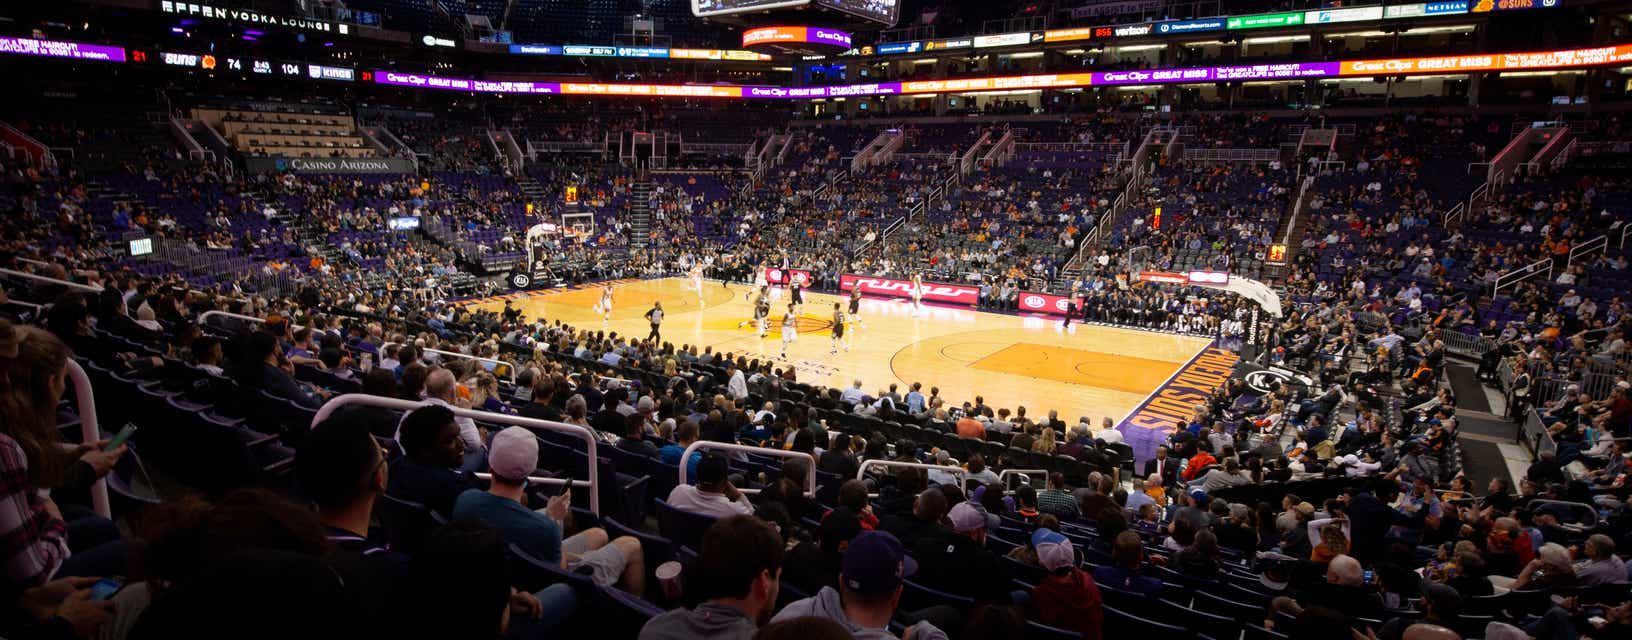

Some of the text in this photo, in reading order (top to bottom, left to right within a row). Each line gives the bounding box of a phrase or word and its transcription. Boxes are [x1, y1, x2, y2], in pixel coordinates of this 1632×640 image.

[162, 1, 330, 31] EFFEN VODKA LOUNGE
[1115, 25, 1148, 36] verizon
[133, 52, 146, 62] 21
[228, 59, 241, 70] 74
[282, 64, 299, 75] 104
[1352, 56, 1492, 72] Great Clips GREAT MISS
[1104, 69, 1207, 82] Great Clips GREAT MISS
[292, 159, 389, 170] CASINO ARIZONA
[1248, 309, 1259, 345] Southwest
[1130, 388, 1208, 433] SUNS
